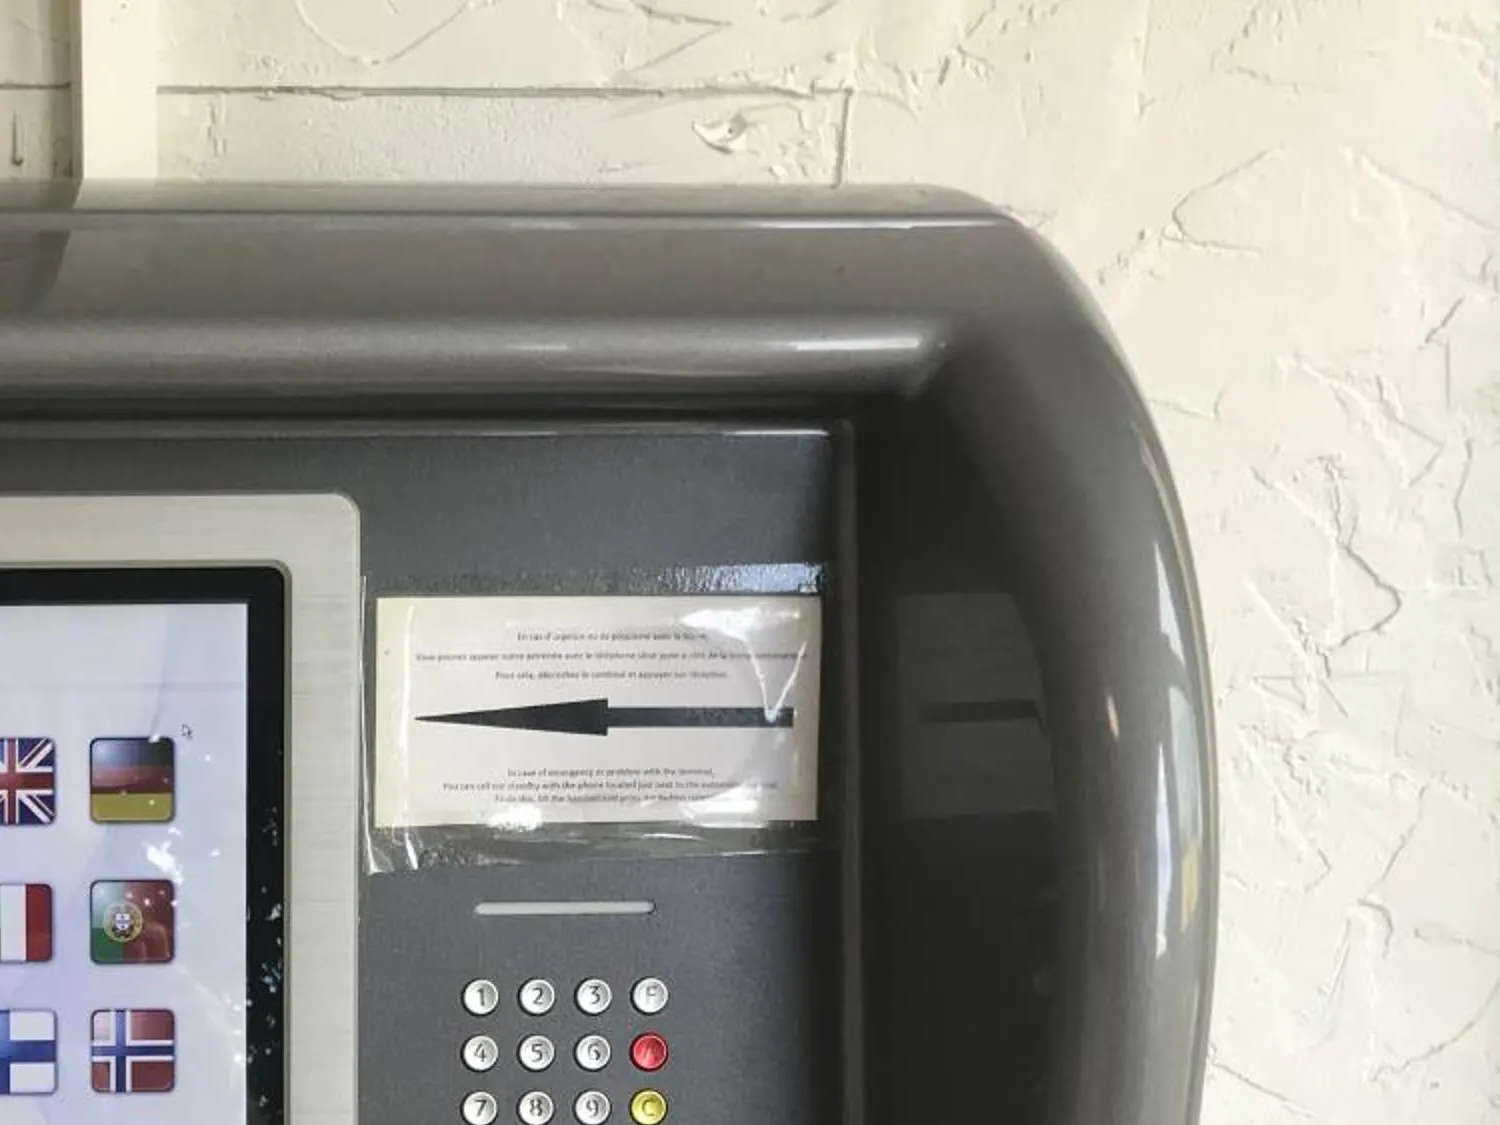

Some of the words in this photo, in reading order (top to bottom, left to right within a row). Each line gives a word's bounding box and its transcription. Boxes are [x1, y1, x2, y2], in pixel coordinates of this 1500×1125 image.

[477, 987, 485, 1007] 1
[532, 987, 544, 1005] 2
[589, 985, 601, 1005] 3
[474, 1043, 487, 1062] 4
[531, 1043, 543, 1063] 5
[588, 1043, 601, 1062] 6
[474, 1099, 487, 1117] 7
[530, 1099, 542, 1117] 8
[586, 1099, 598, 1118] 9
[642, 1100, 655, 1117] C
